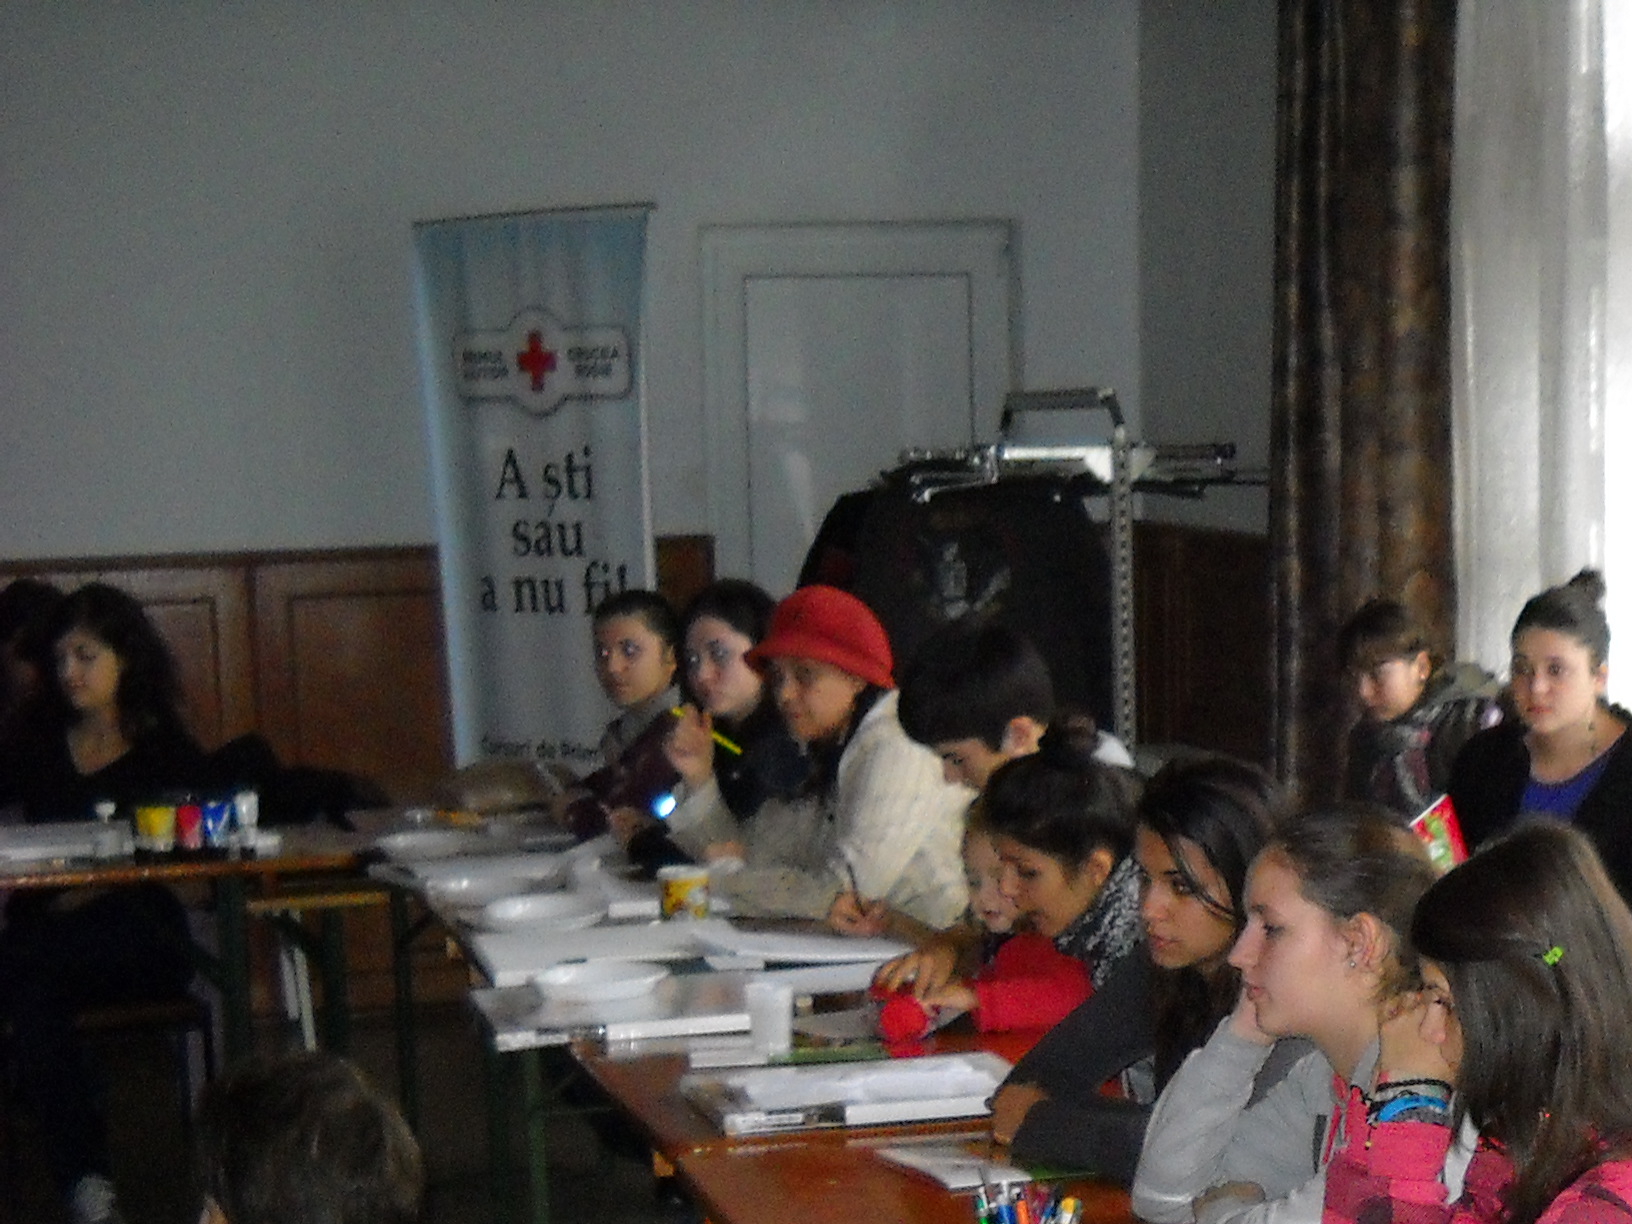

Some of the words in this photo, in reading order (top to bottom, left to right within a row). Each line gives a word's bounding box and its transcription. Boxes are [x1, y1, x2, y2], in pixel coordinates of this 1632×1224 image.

[495, 448, 529, 499] A
[511, 519, 585, 557] sau
[480, 575, 497, 613] a
[512, 575, 565, 615] nu
